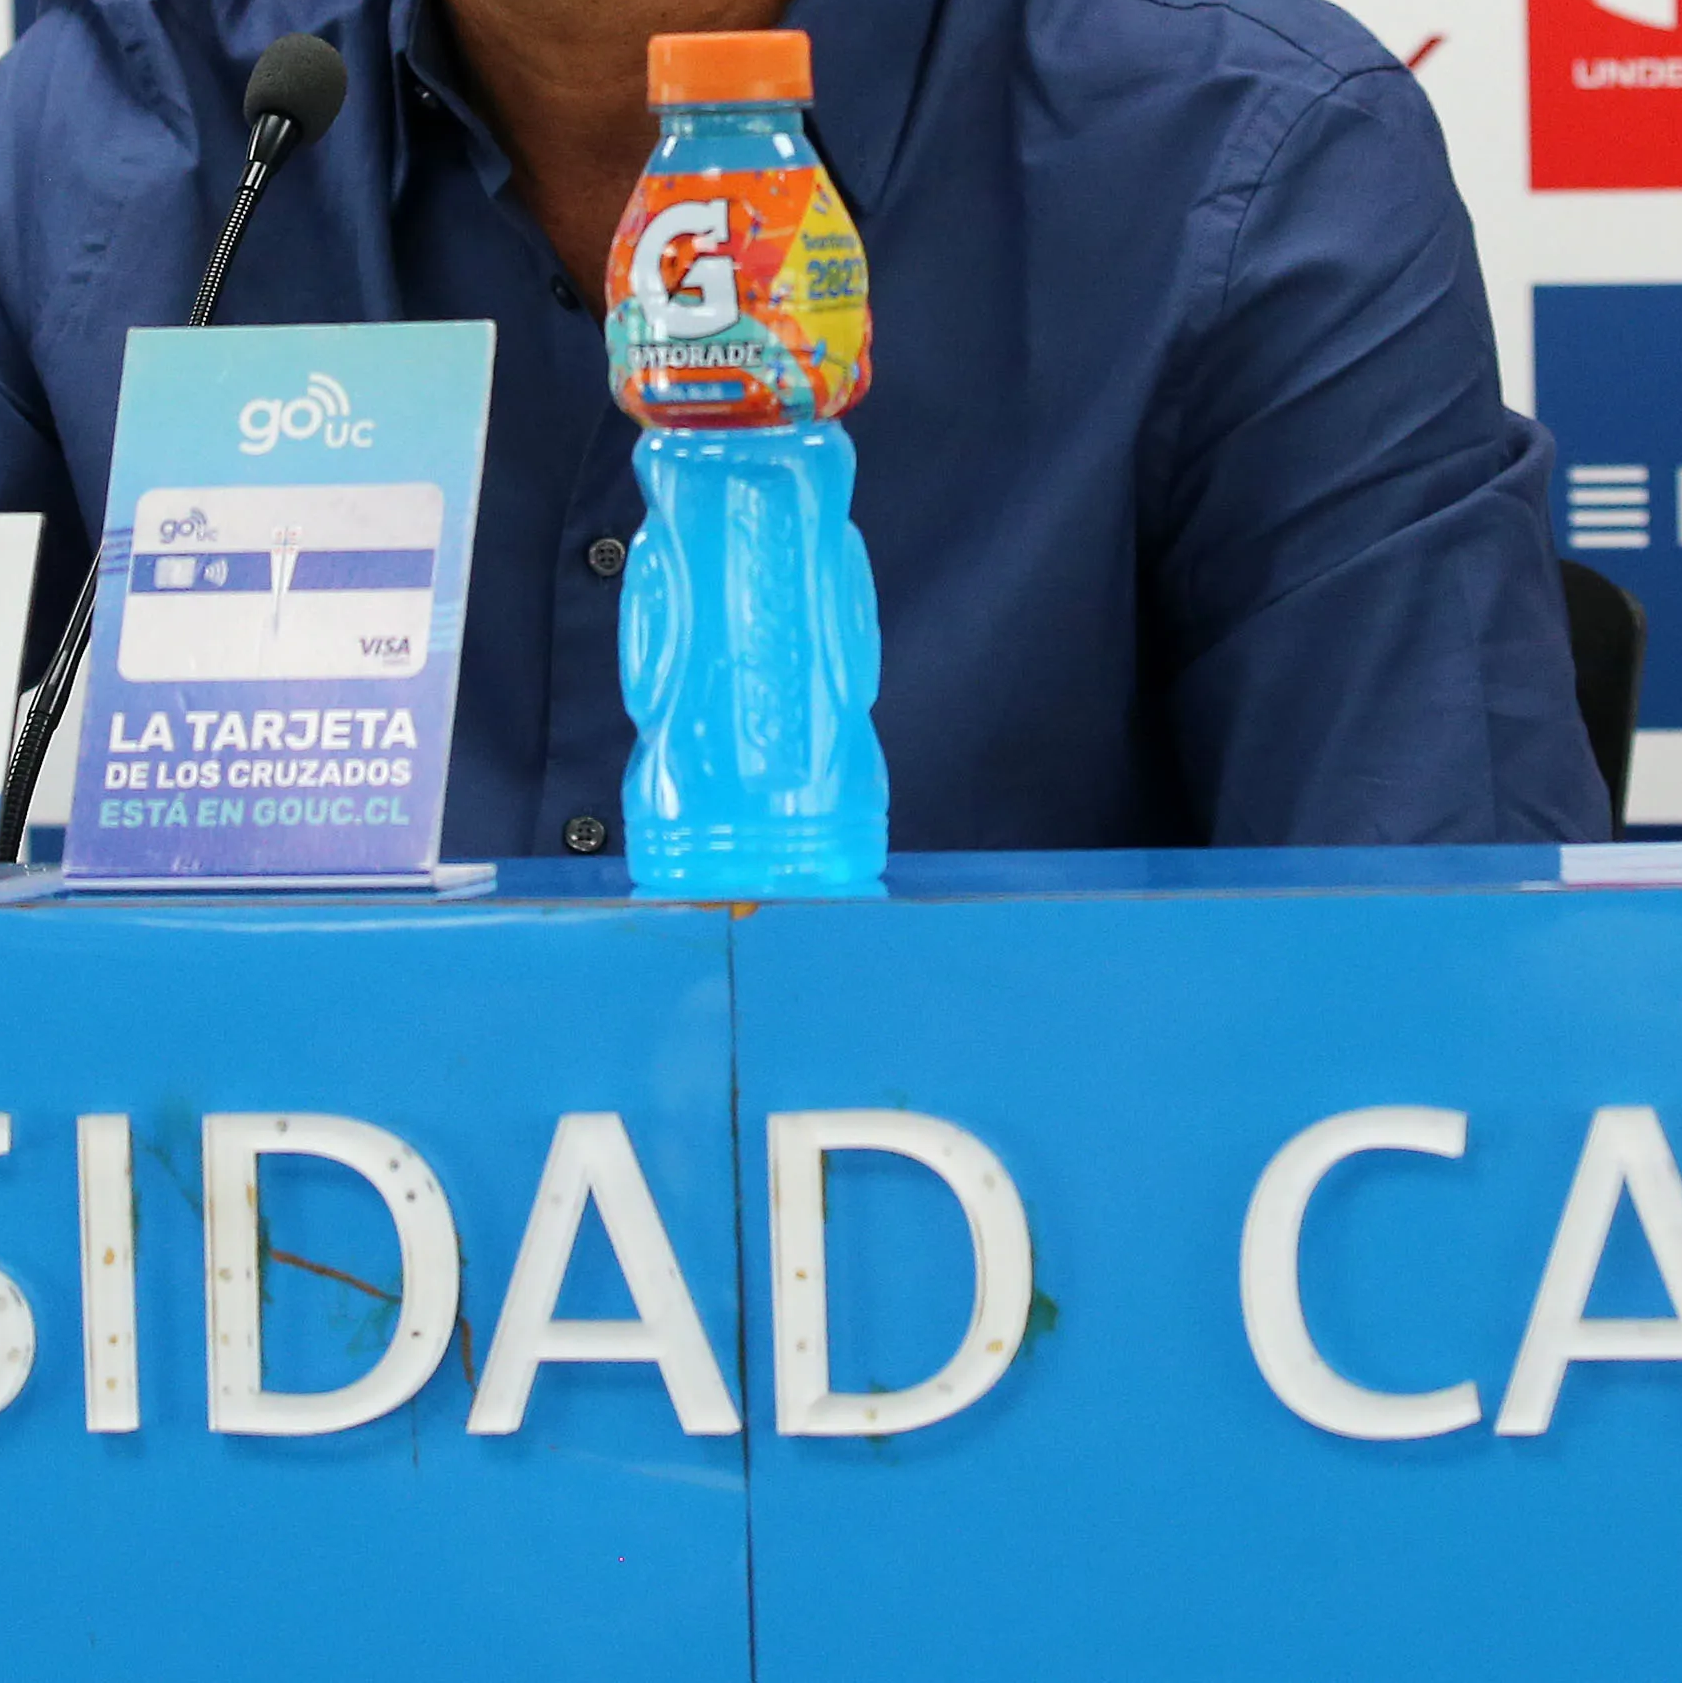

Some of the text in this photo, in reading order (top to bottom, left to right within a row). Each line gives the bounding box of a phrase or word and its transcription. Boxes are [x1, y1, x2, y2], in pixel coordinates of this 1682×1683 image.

[630, 199, 741, 340] G
[360, 635, 411, 656] VISA
[108, 708, 418, 752] LA TARJETA
[104, 758, 412, 789] DE LOS CRUZADOS
[99, 793, 410, 829] ESTÁ EN GOUC.CL
